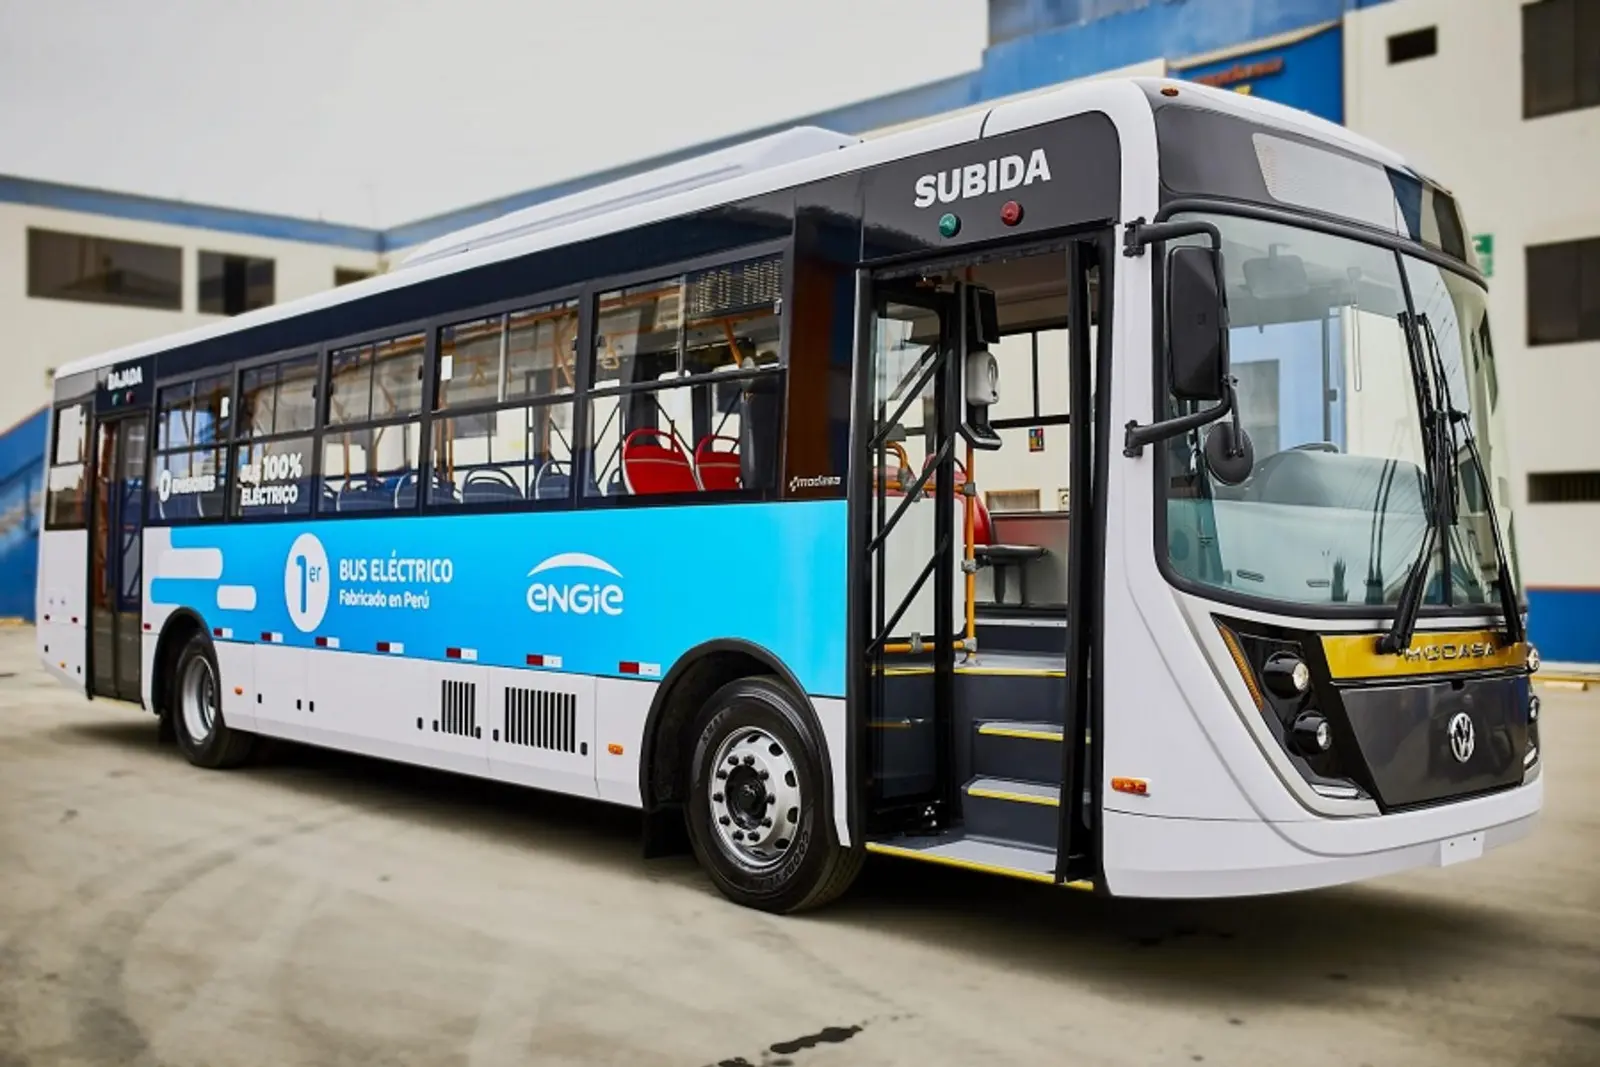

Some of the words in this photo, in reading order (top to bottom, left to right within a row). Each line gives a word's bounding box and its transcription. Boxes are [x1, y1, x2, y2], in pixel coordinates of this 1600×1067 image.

[914, 148, 1052, 208] SUBIDA
[263, 453, 302, 481] 100%
[339, 558, 368, 582] BUS
[370, 549, 454, 583] ELÉCTRICO
[339, 588, 387, 608] Fabricado
[388, 594, 402, 608] en
[404, 590, 431, 610] Perú
[1403, 641, 1496, 662] MODASA
